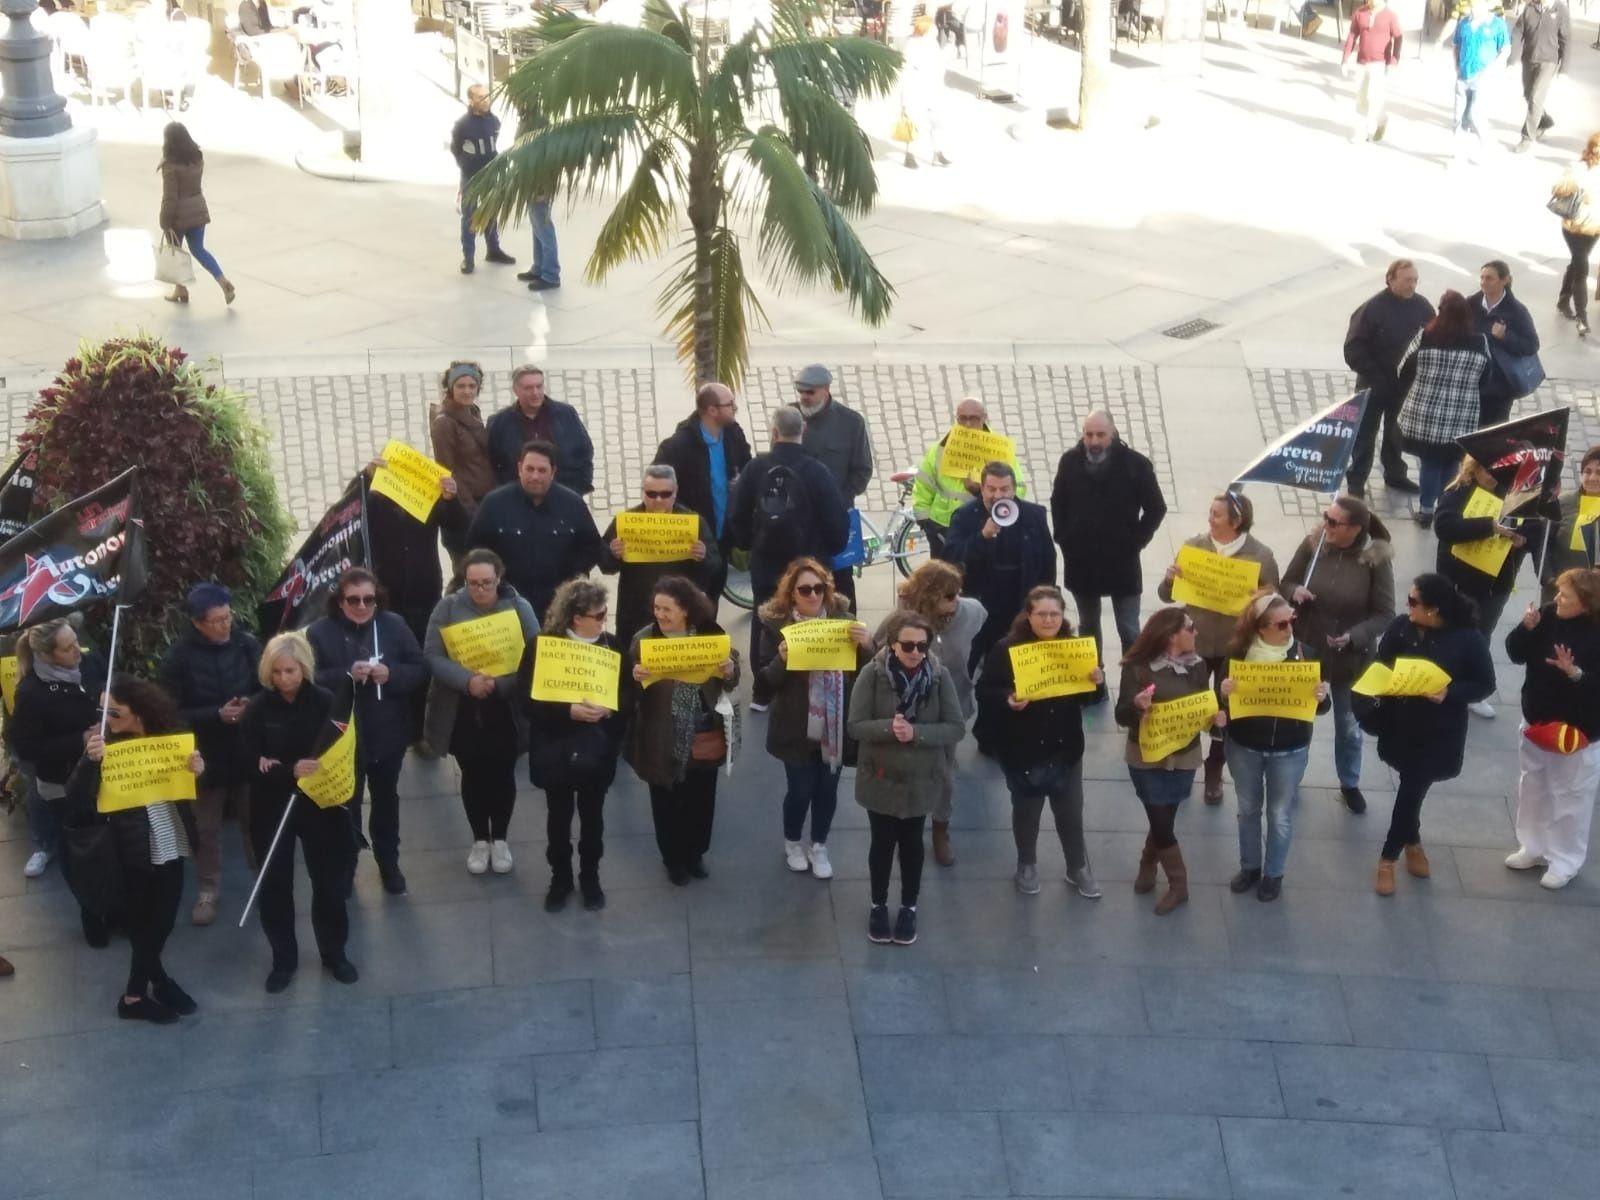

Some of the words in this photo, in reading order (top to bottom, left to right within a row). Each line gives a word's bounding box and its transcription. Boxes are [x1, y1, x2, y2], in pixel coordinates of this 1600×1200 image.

[544, 639, 557, 647] LO
[652, 641, 719, 653] SOPORTAMOS
[541, 651, 566, 660] HACE
[570, 653, 593, 663] TRES
[1017, 647, 1029, 656] LO
[647, 655, 678, 664] MAYOR
[680, 654, 709, 662] CARGA
[564, 666, 596, 678] KICHI
[1234, 663, 1247, 671] LO
[1249, 663, 1315, 672] PROMETISTE
[1163, 694, 1209, 712] PLIEGOS
[1187, 708, 1208, 720] QUE
[107, 742, 180, 760] SOPORTAMOS
[102, 759, 136, 772] MAYOR
[138, 755, 171, 766] CARGA
